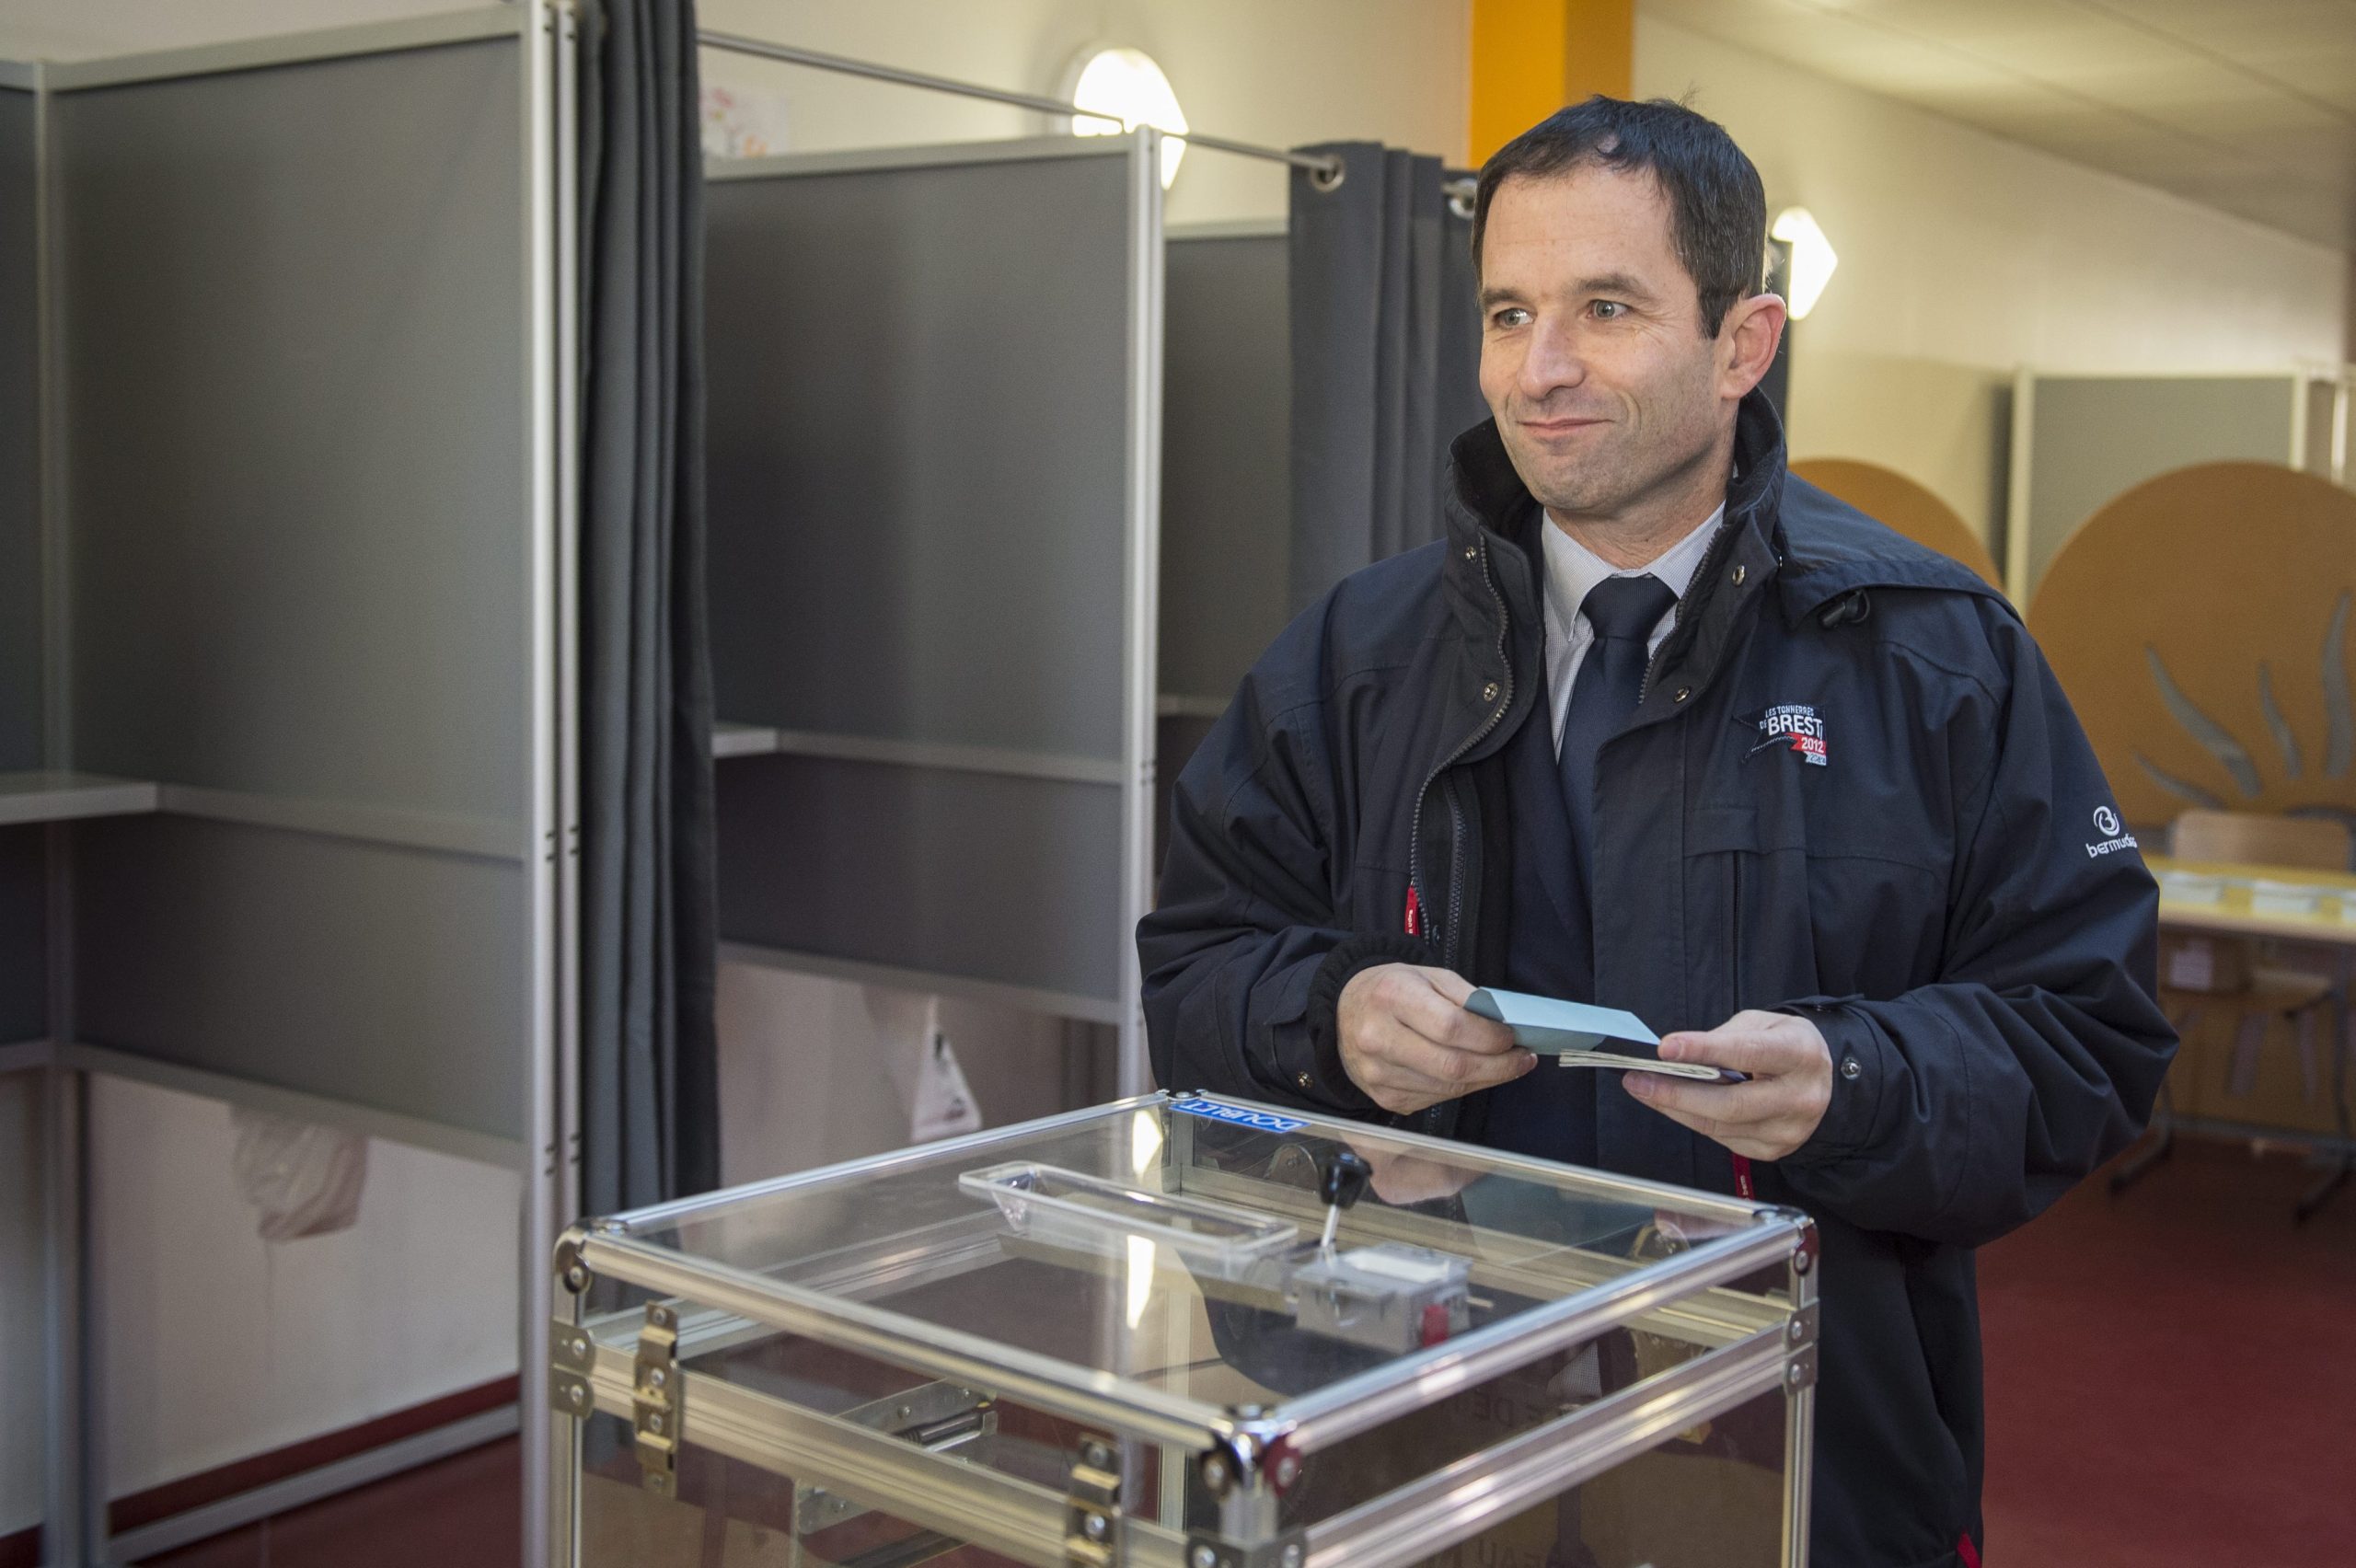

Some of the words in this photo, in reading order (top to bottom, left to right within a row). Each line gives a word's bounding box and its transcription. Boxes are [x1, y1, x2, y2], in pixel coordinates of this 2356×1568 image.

[1765, 708, 1777, 719] LES
[1777, 704, 1814, 717] TONNERRES
[1767, 714, 1823, 739] BREST
[1801, 737, 1824, 753] 2012
